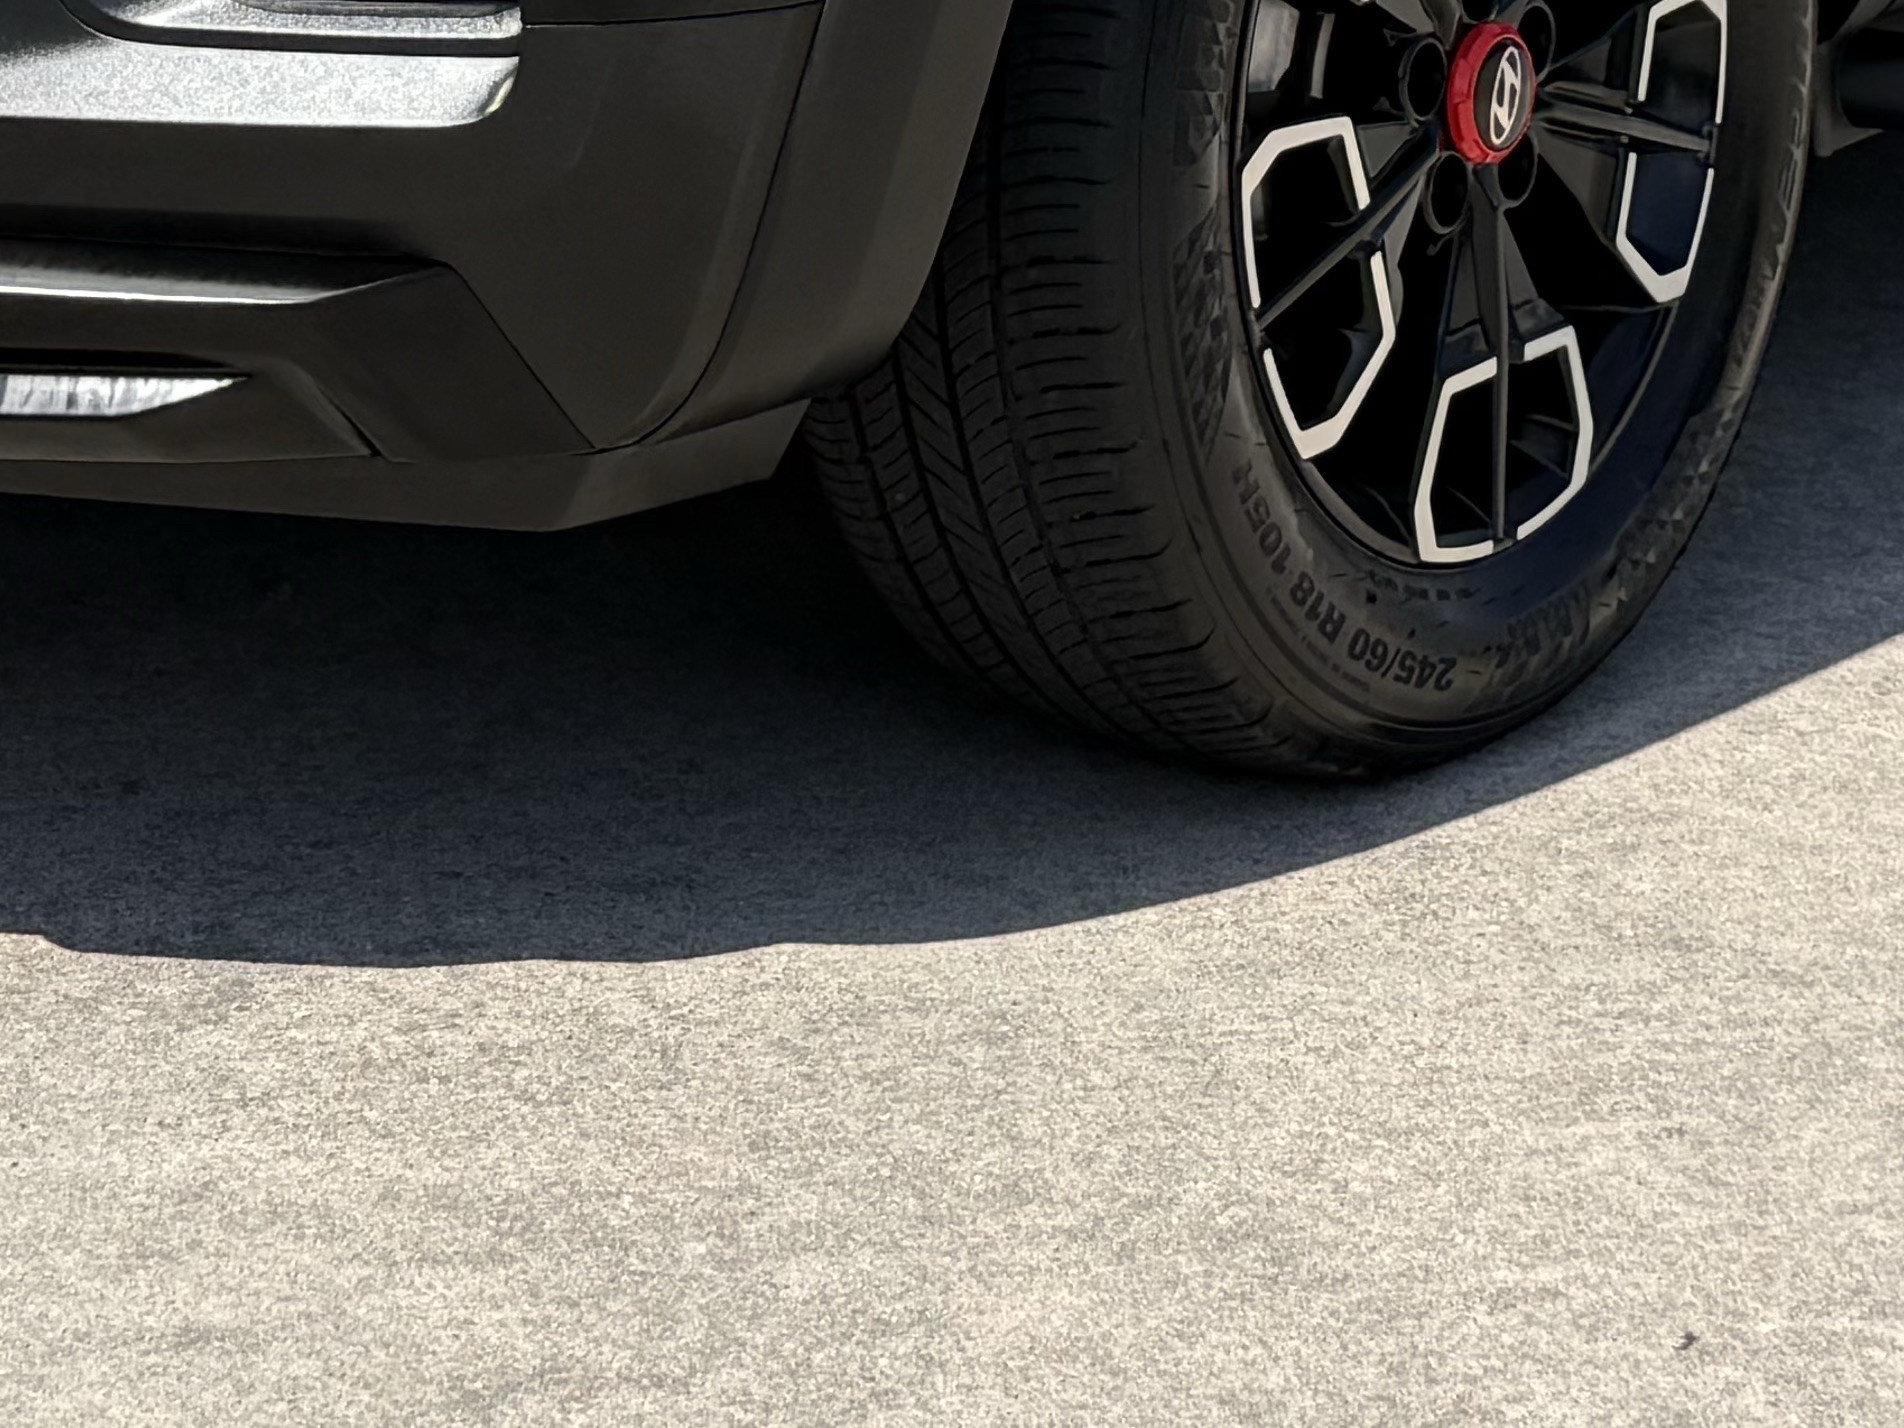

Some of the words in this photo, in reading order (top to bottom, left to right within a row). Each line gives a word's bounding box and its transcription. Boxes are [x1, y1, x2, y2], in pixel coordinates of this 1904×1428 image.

[1231, 463, 1292, 575] 105H
[1288, 570, 1347, 644] R18
[1347, 626, 1458, 692] 245/60
